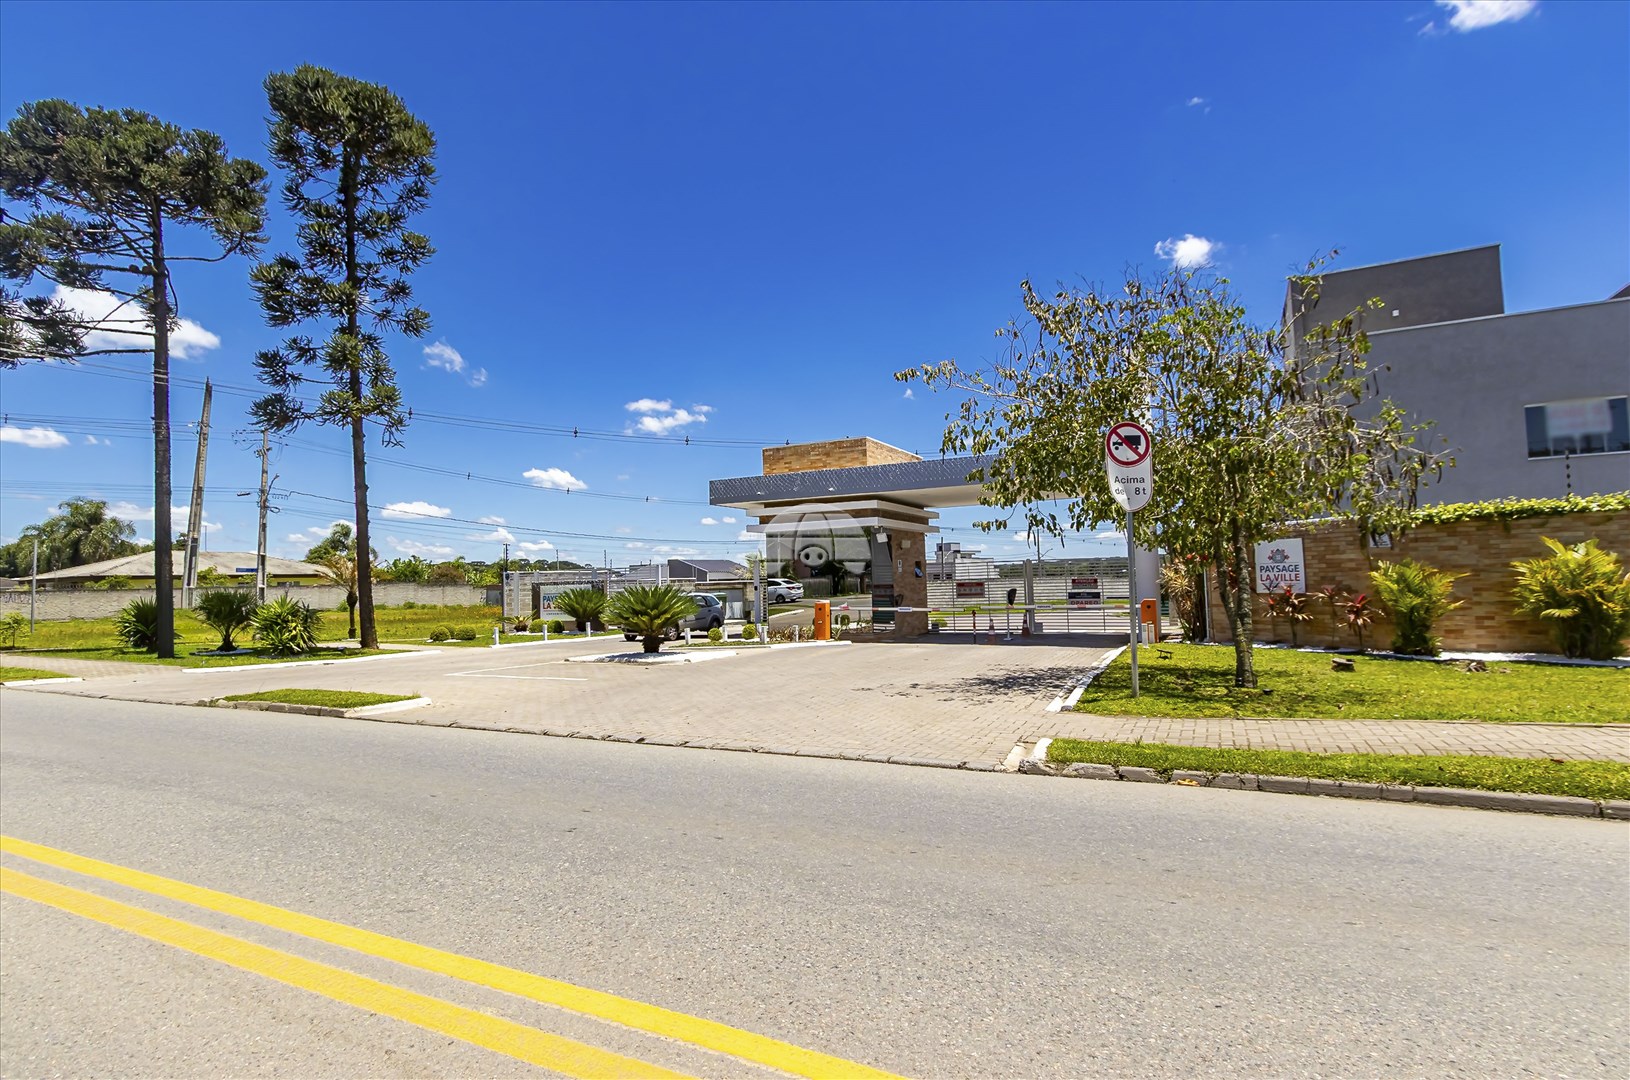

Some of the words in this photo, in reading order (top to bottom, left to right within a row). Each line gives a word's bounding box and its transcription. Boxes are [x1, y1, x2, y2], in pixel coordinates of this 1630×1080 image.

[1114, 475, 1145, 484] Acima
[1259, 564, 1300, 573] PAYSAGE
[1260, 574, 1272, 582] LA
[1273, 573, 1301, 582] VILLE
